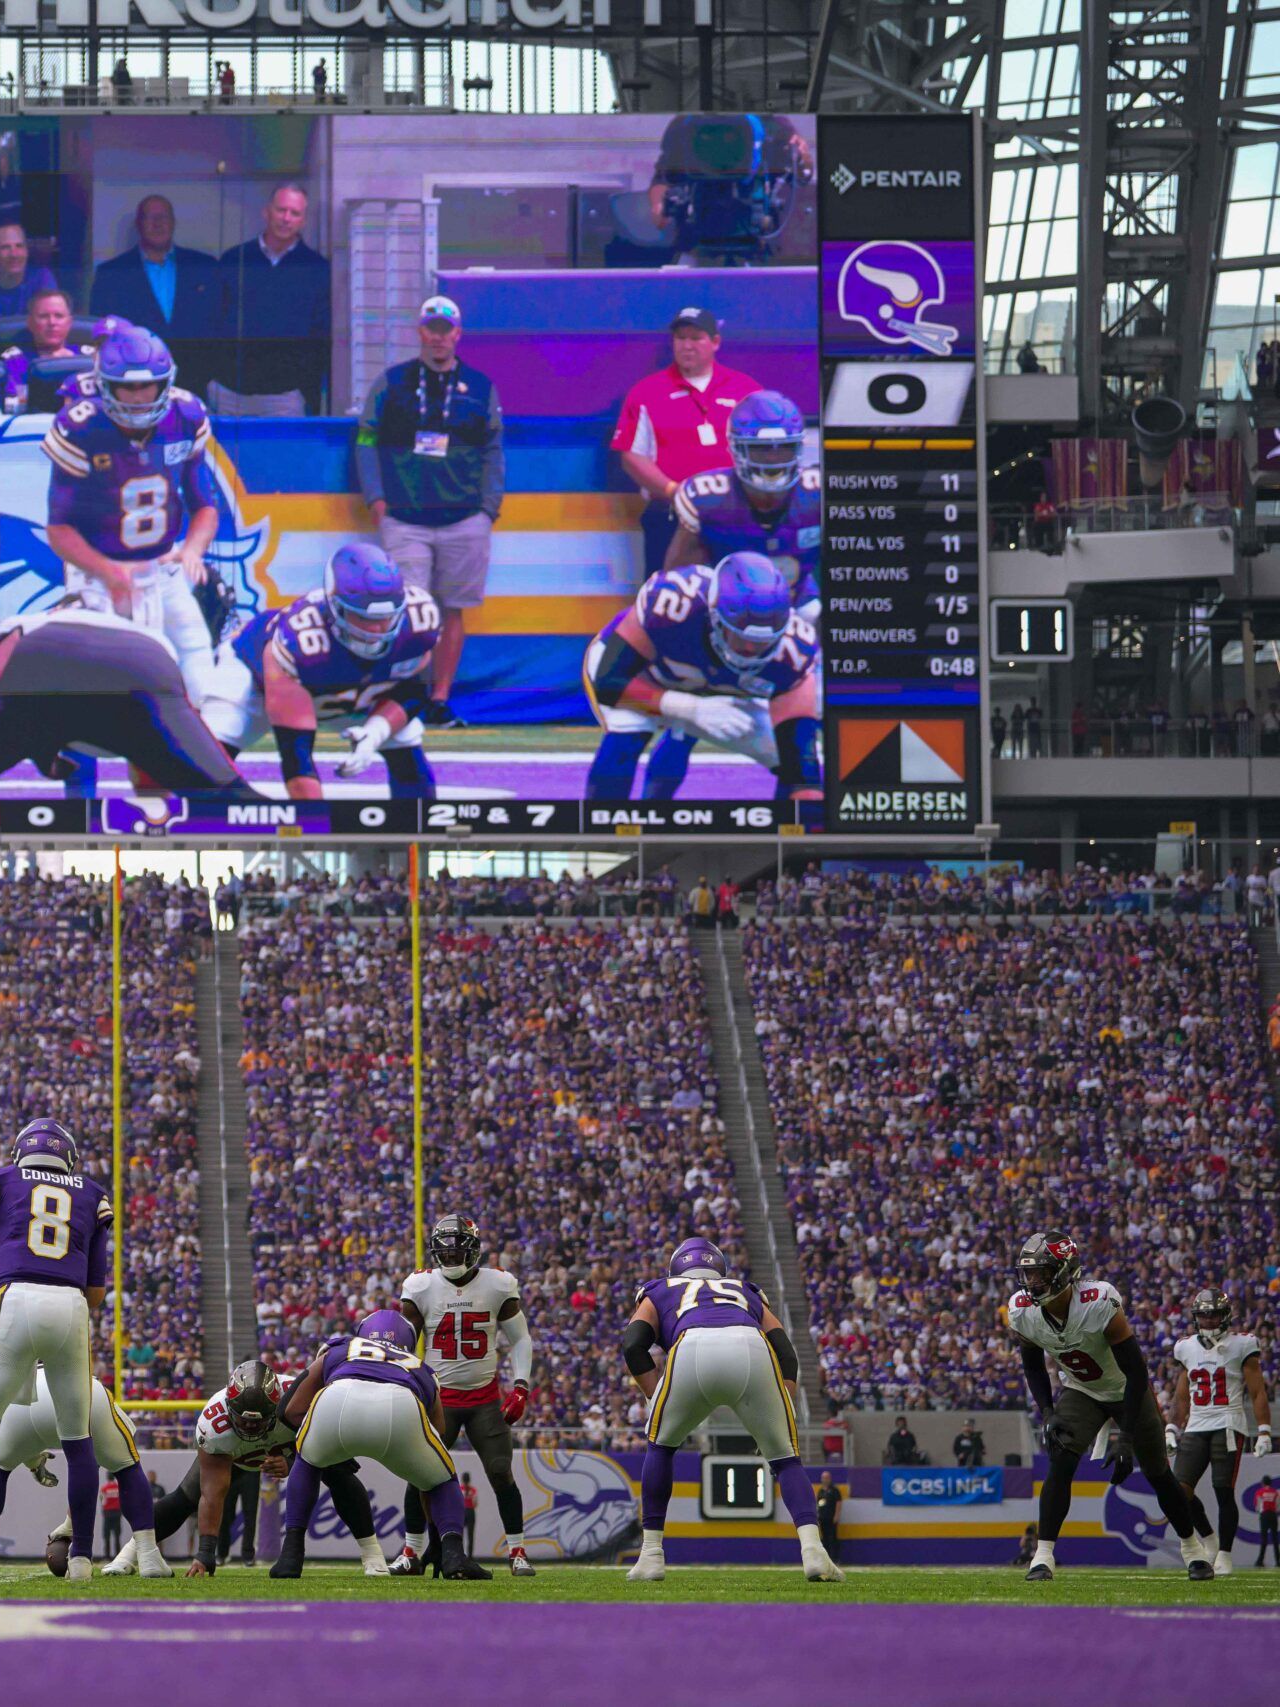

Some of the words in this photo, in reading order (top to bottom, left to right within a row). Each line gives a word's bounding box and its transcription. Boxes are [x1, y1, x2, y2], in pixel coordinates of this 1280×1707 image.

[860, 169, 962, 188] PENTAIR
[867, 372, 927, 415] 0
[829, 475, 869, 490] RUSH
[870, 475, 899, 490] YDS
[940, 473, 961, 493] 11
[120, 473, 170, 549] 8
[829, 506, 866, 520] PASS
[868, 506, 896, 520] YDS
[829, 536, 875, 551] TOTAL
[877, 536, 905, 551] YDS
[941, 534, 961, 554] 11
[829, 567, 854, 581] 1ST
[856, 567, 910, 581] DOWNS
[830, 597, 894, 613] PEN/YDS
[934, 595, 969, 616] 1/5
[830, 628, 917, 643] TURNOVERS
[1020, 609, 1063, 652] 11
[830, 659, 870, 674] T.O.P.
[930, 657, 975, 677] 0:48
[839, 791, 968, 812] ANDERSEN
[227, 804, 297, 825] MIN
[427, 803, 481, 827] 2ND
[486, 806, 510, 824] &
[526, 804, 556, 827] 7
[590, 809, 666, 825] BALL
[672, 809, 713, 825] ON
[729, 806, 774, 827] 16
[839, 812, 903, 822] WINDOWS
[923, 812, 968, 822] DOORS
[21, 1168, 84, 1189] COUSINS
[27, 1183, 72, 1260] 8
[667, 1277, 749, 1319] 75
[431, 1310, 491, 1361] 45
[1058, 1350, 1104, 1383] 9
[1189, 1367, 1230, 1407] 31
[202, 1401, 233, 1435] 50
[726, 1467, 765, 1504] 11
[907, 1477, 945, 1496] CBS
[955, 1475, 996, 1495] NFL
